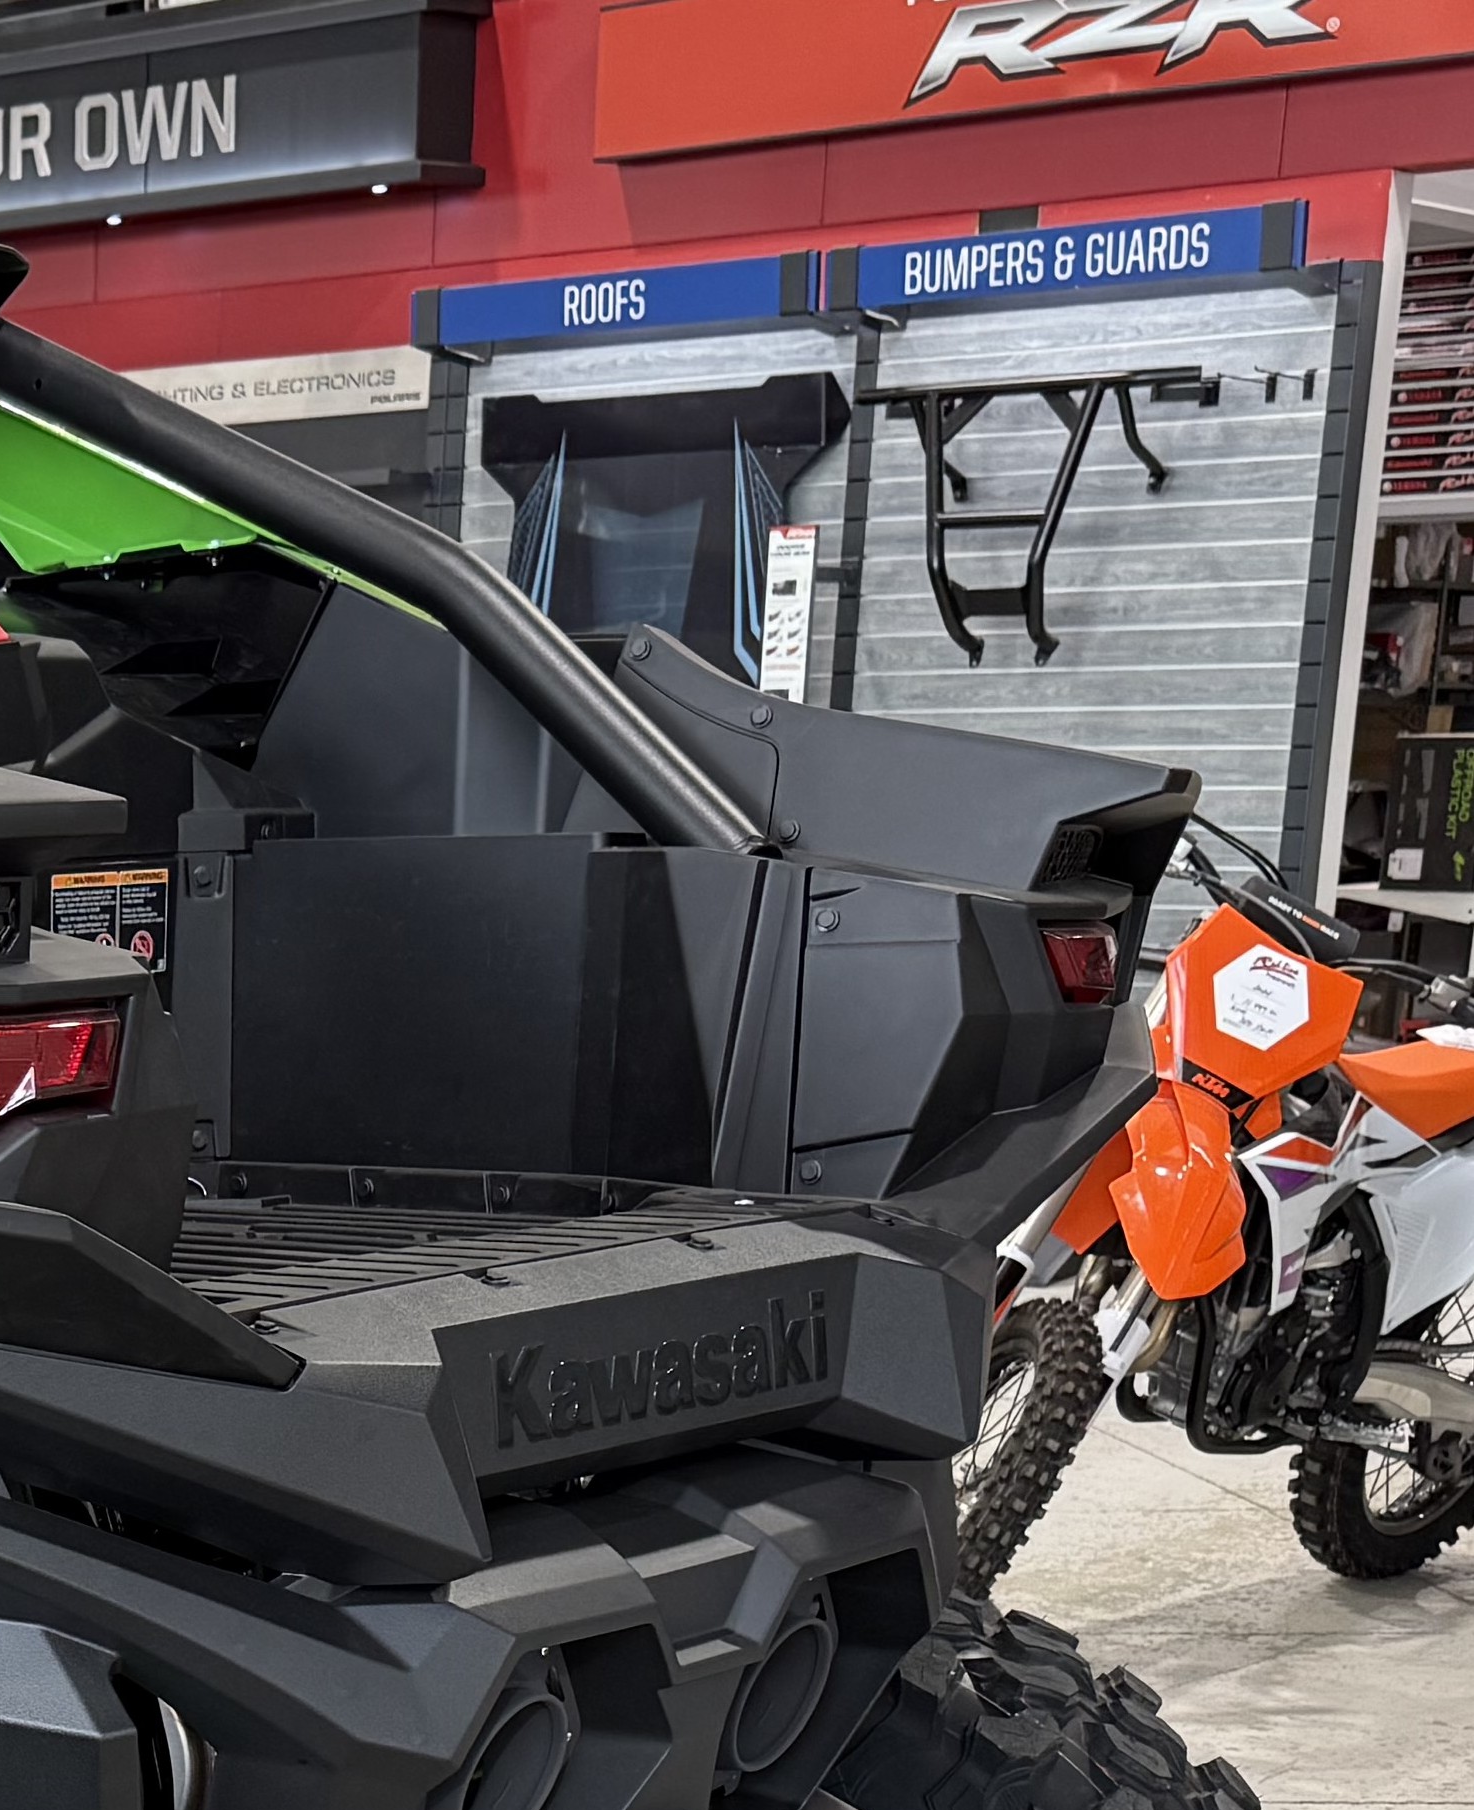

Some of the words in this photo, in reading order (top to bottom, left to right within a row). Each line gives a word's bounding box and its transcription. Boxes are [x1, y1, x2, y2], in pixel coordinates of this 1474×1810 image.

[74, 73, 238, 172] OWN
[903, 238, 1045, 297] BUMPERS
[1054, 234, 1076, 281] &
[1085, 222, 1211, 278] GUARDS
[563, 279, 646, 327] ROOFS
[231, 381, 247, 400] &
[253, 368, 397, 398] ELECTRONICS
[489, 1290, 830, 1448] Kawasaki
